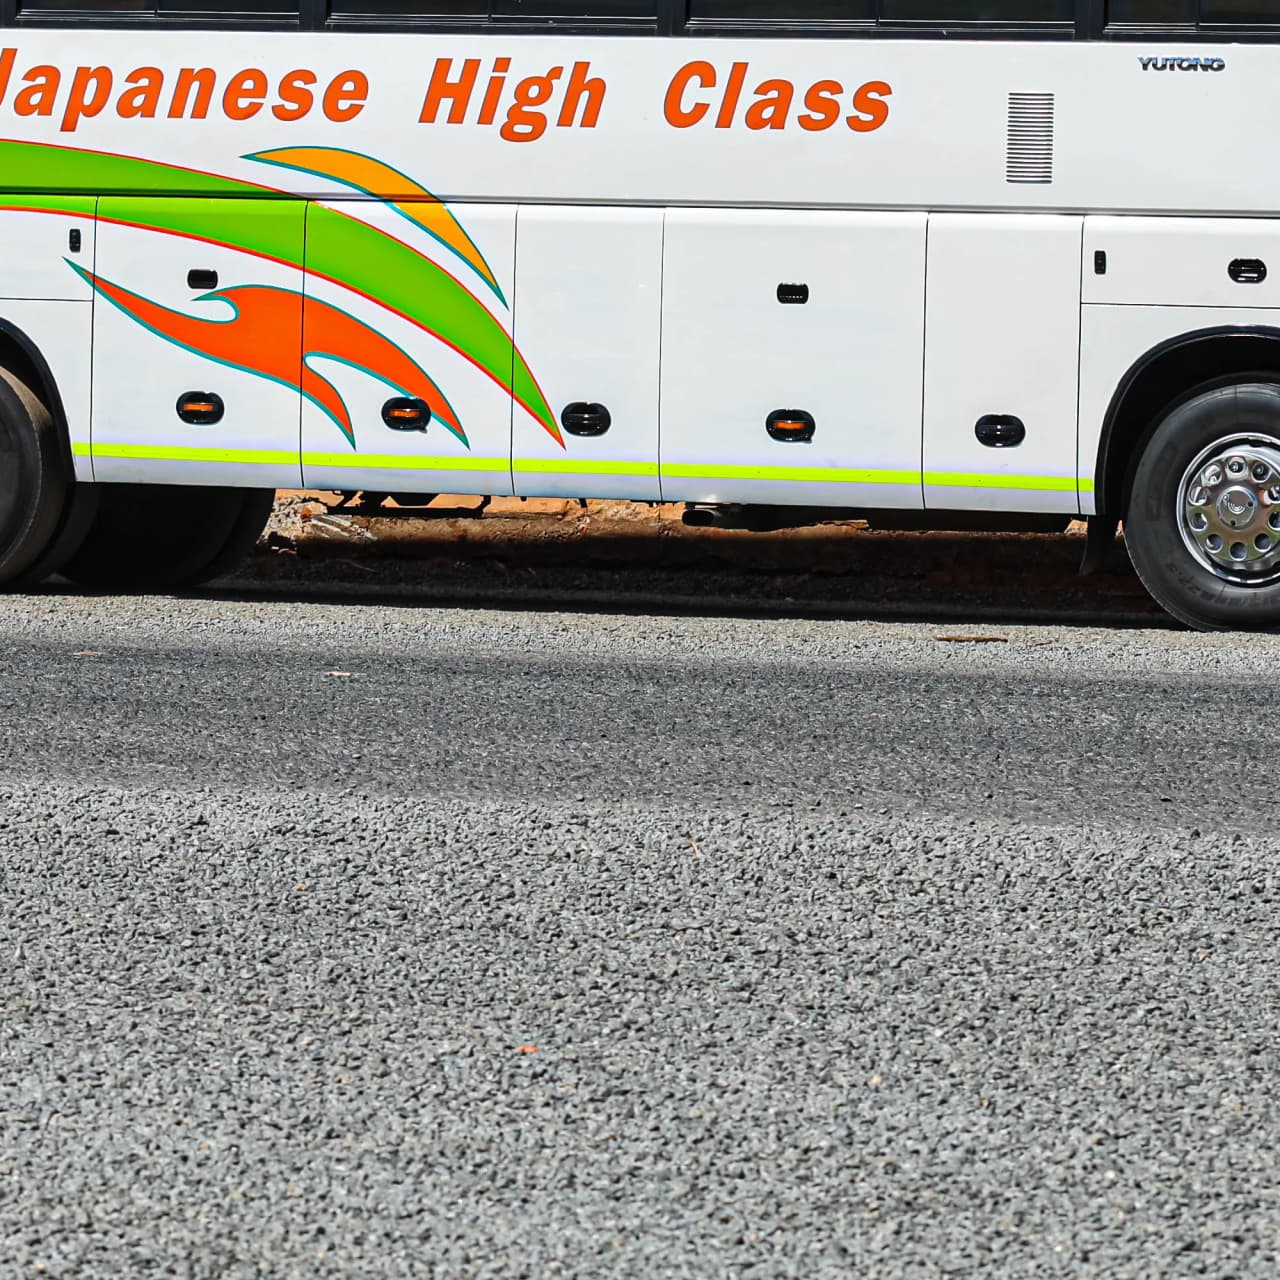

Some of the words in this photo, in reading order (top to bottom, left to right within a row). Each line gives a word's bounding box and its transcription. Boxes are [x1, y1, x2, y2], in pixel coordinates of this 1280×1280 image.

[1138, 56, 1226, 72] YUTONG
[420, 57, 607, 143] High
[664, 60, 893, 133] Class
